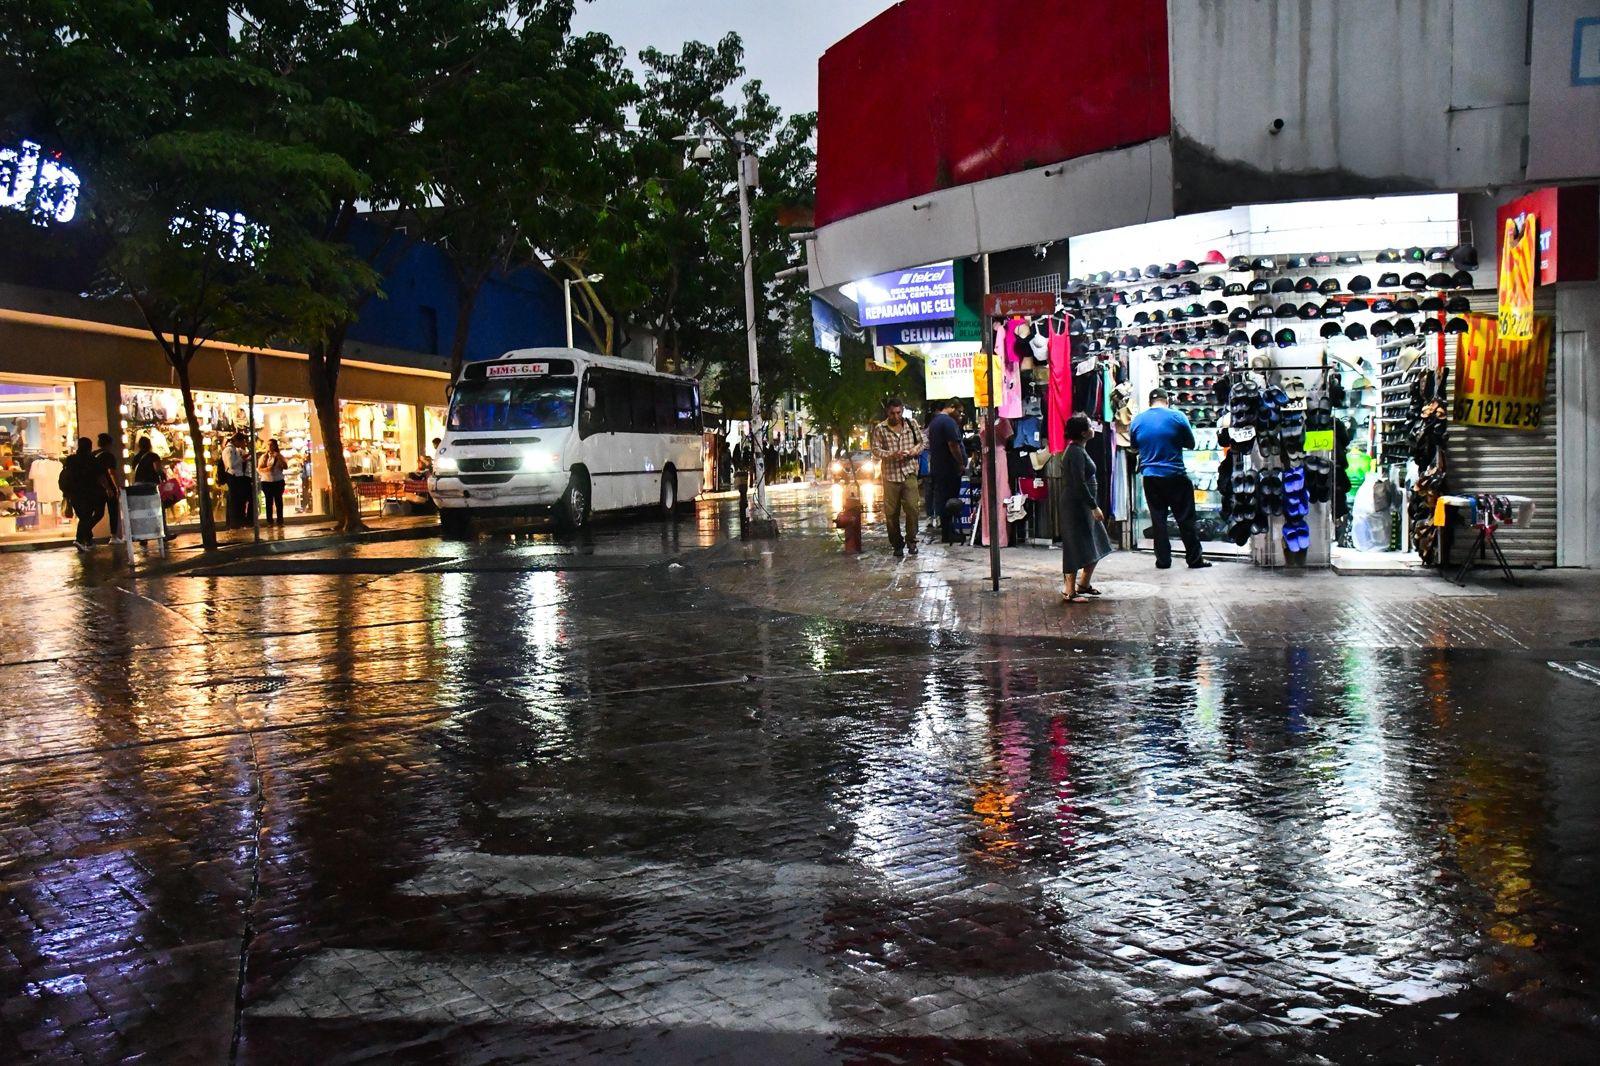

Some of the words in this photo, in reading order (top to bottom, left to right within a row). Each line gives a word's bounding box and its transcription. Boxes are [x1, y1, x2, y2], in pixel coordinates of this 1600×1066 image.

[911, 269, 945, 283] telcel
[865, 300, 919, 320] REPARACIÓN
[921, 301, 932, 314] DE
[901, 326, 954, 343] CELULAR
[948, 358, 973, 369] GRAT
[1478, 400, 1501, 424] 191
[1503, 402, 1522, 425] 22
[1523, 403, 1542, 427] 38
